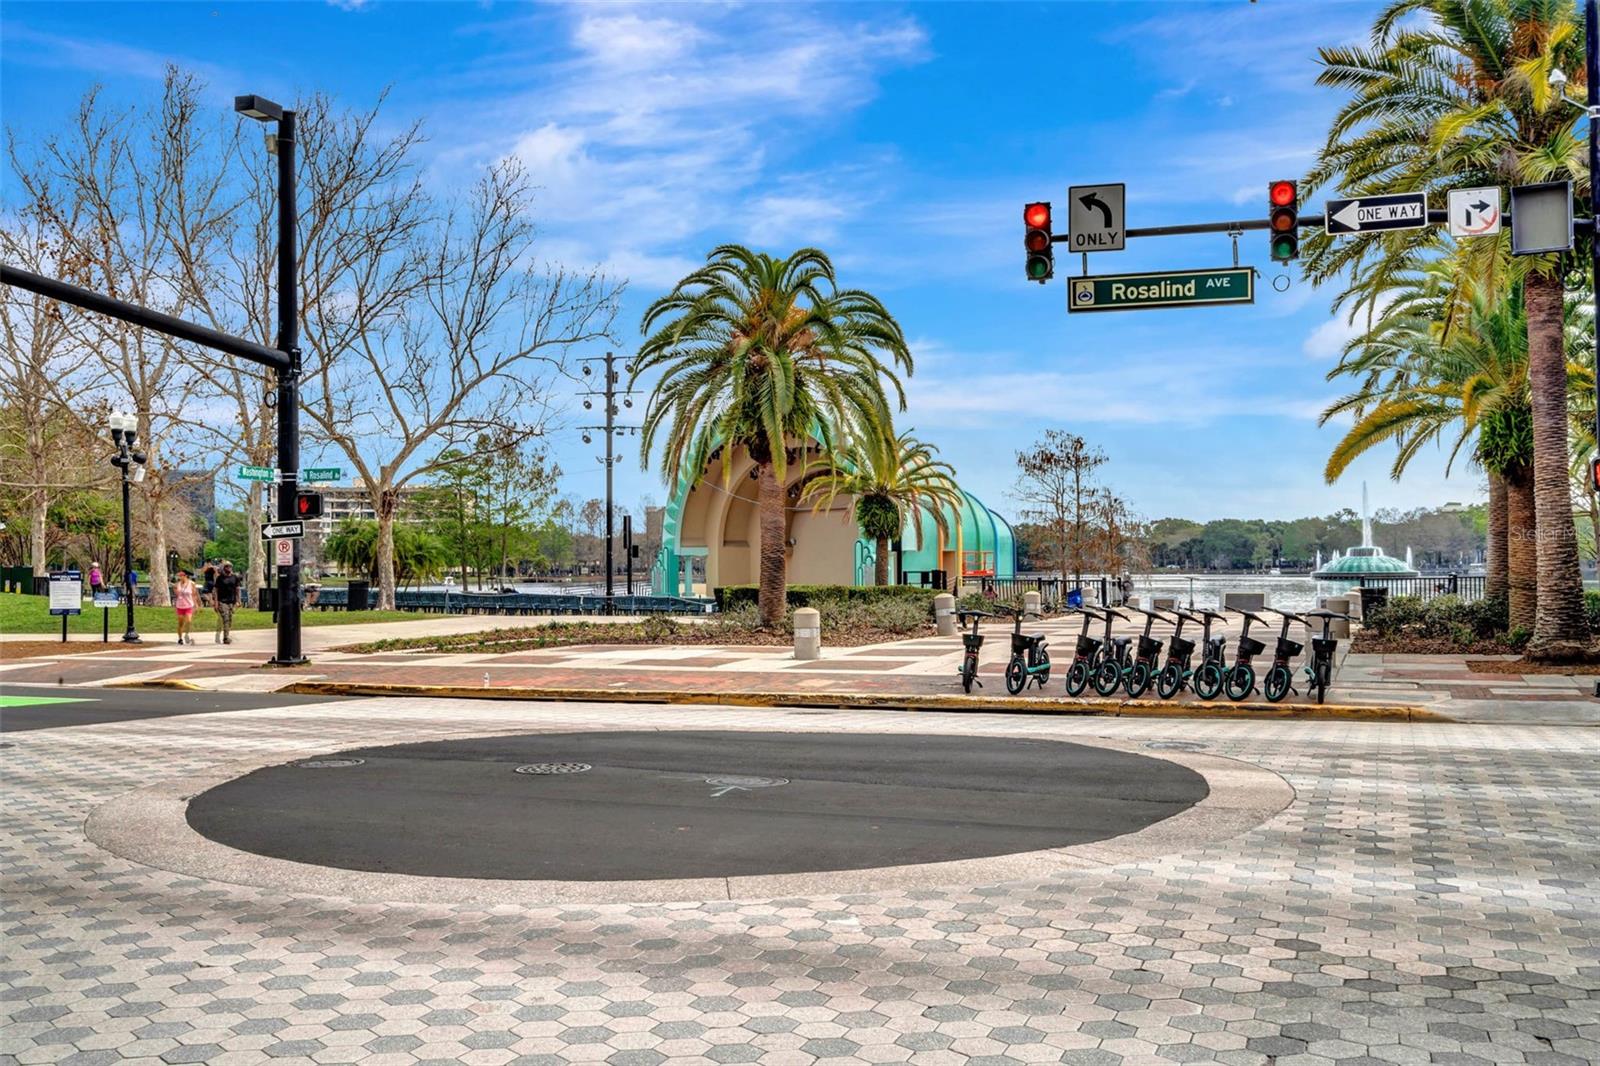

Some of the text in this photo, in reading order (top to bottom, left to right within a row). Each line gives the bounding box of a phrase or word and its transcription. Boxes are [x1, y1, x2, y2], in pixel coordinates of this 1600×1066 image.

[1358, 205, 1418, 221] ONE WAY
[1076, 232, 1118, 246] ONLY
[1112, 277, 1231, 300] Rosalind AVE
[309, 471, 334, 479] Rosalind
